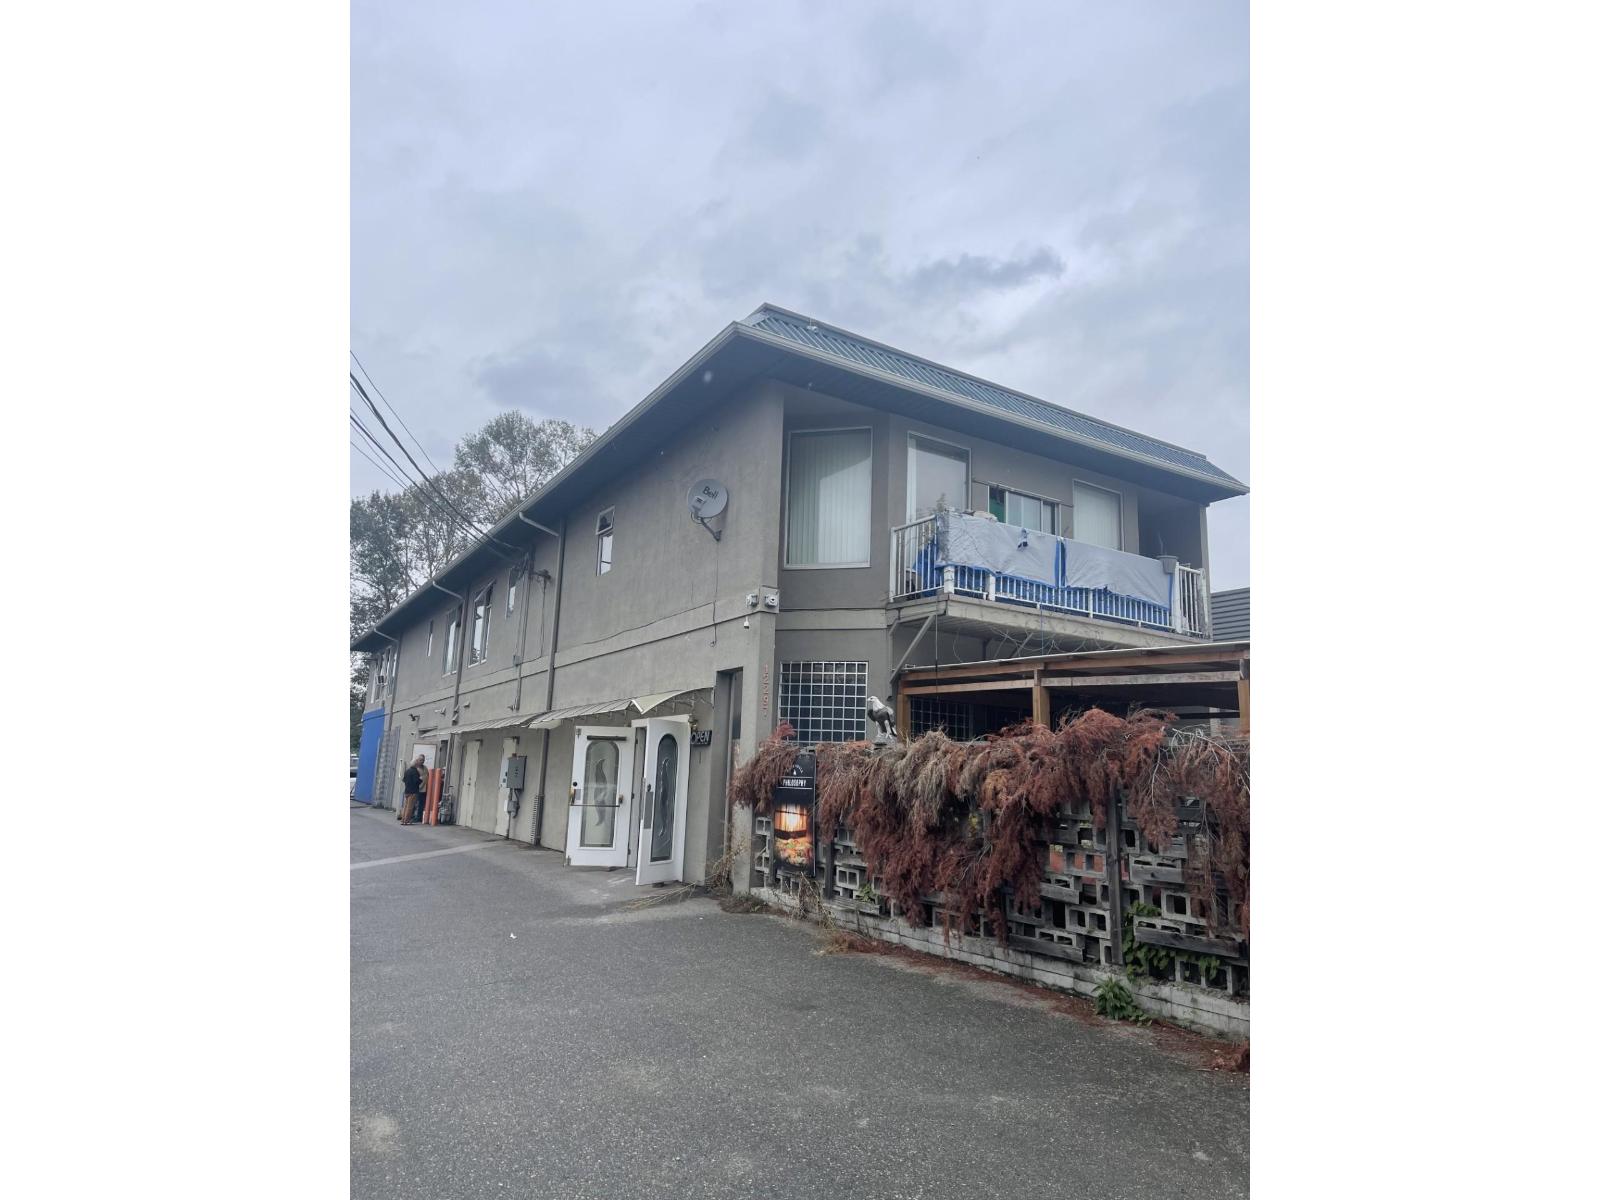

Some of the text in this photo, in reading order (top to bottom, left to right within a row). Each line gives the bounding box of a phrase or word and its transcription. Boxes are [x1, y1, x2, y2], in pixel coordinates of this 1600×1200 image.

[703, 486, 719, 499] Bell
[690, 731, 710, 745] OPEN
[782, 779, 807, 787] PHILOSOPHY
